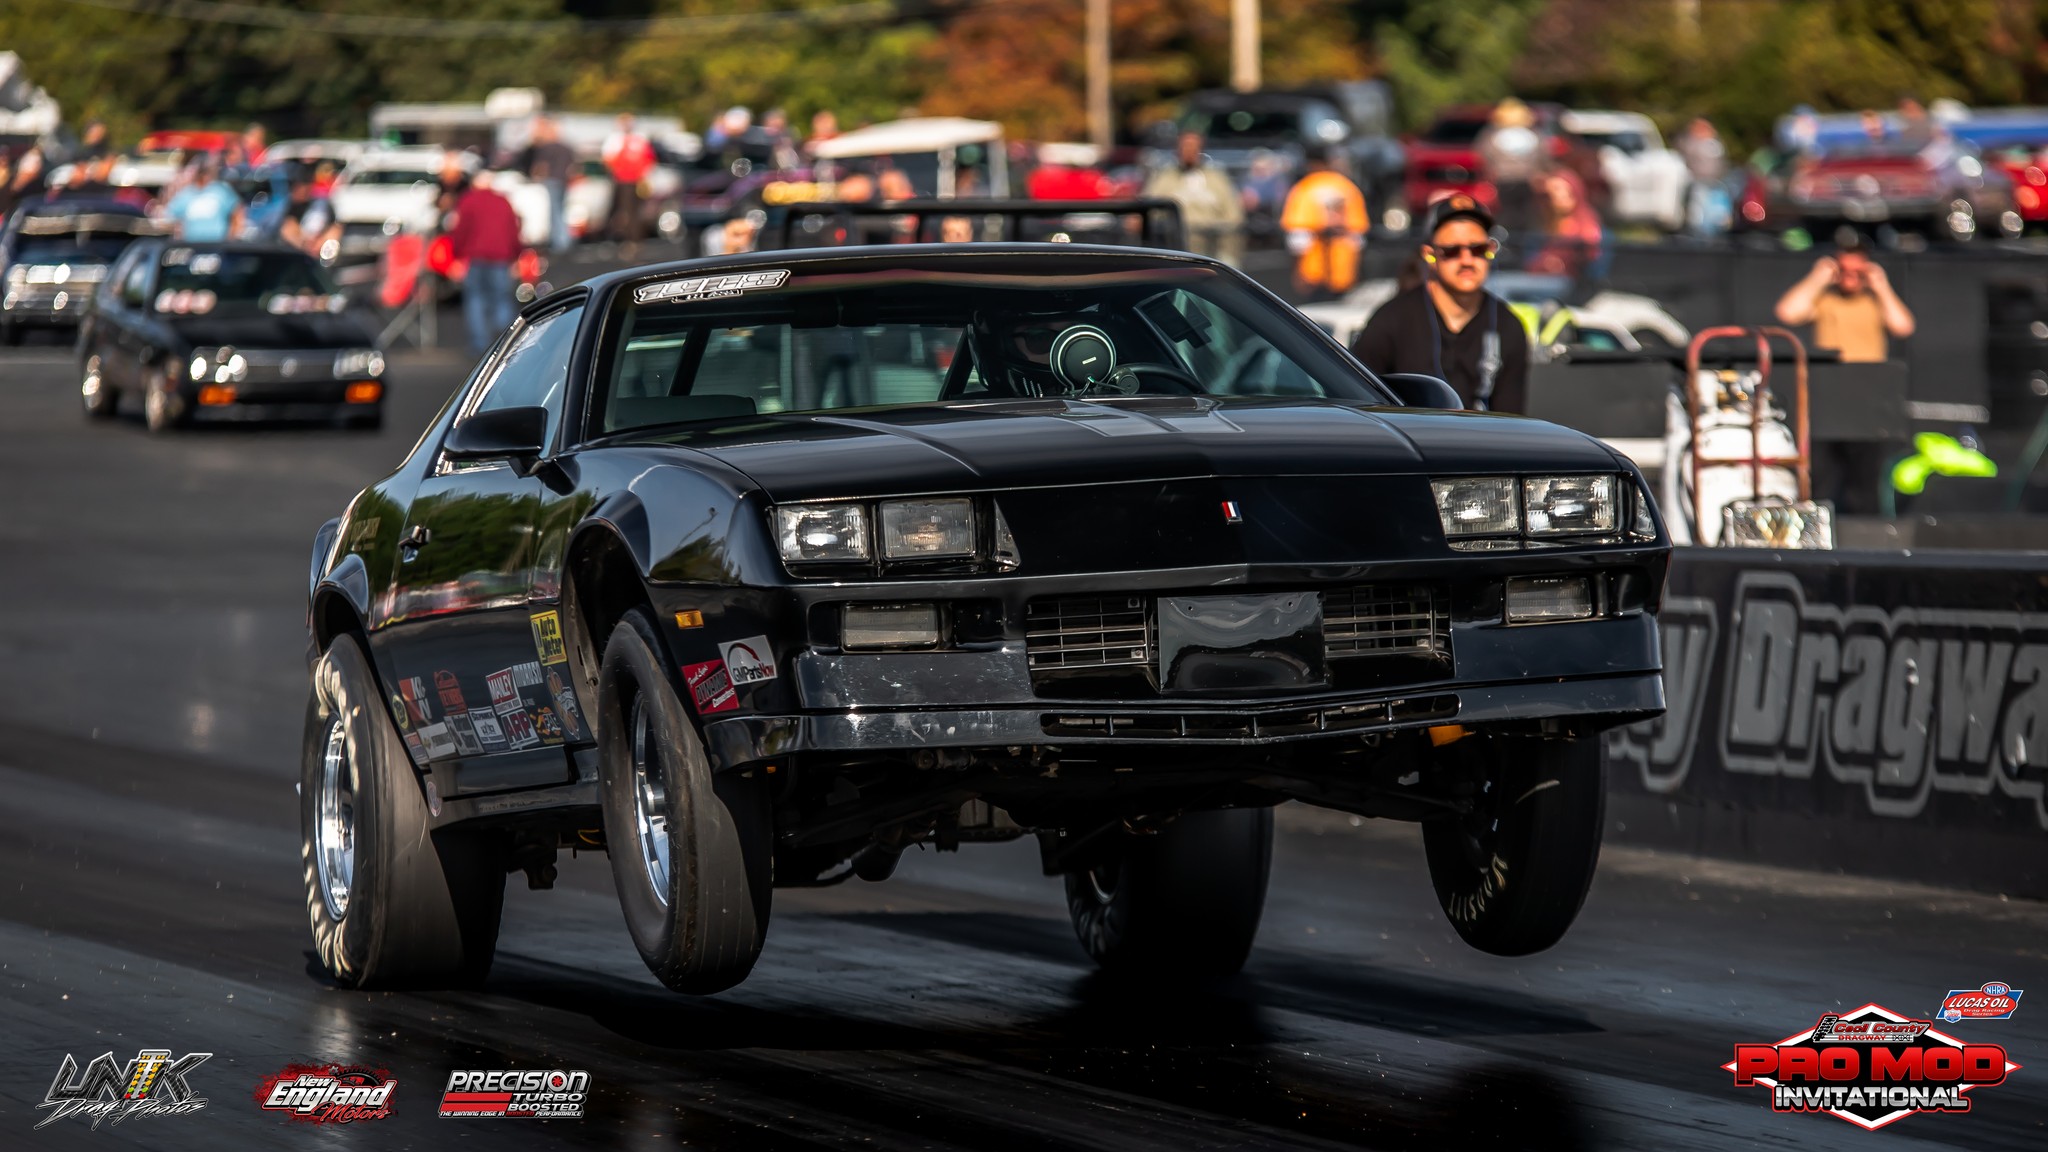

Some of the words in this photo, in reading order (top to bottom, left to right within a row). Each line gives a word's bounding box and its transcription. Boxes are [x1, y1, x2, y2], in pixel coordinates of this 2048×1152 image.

[540, 617, 557, 637] Auto
[488, 674, 513, 700] MANLEY
[696, 668, 728, 704] DYNAMIC
[1728, 599, 2048, 788] Dragwa
[502, 710, 531, 743] ARP
